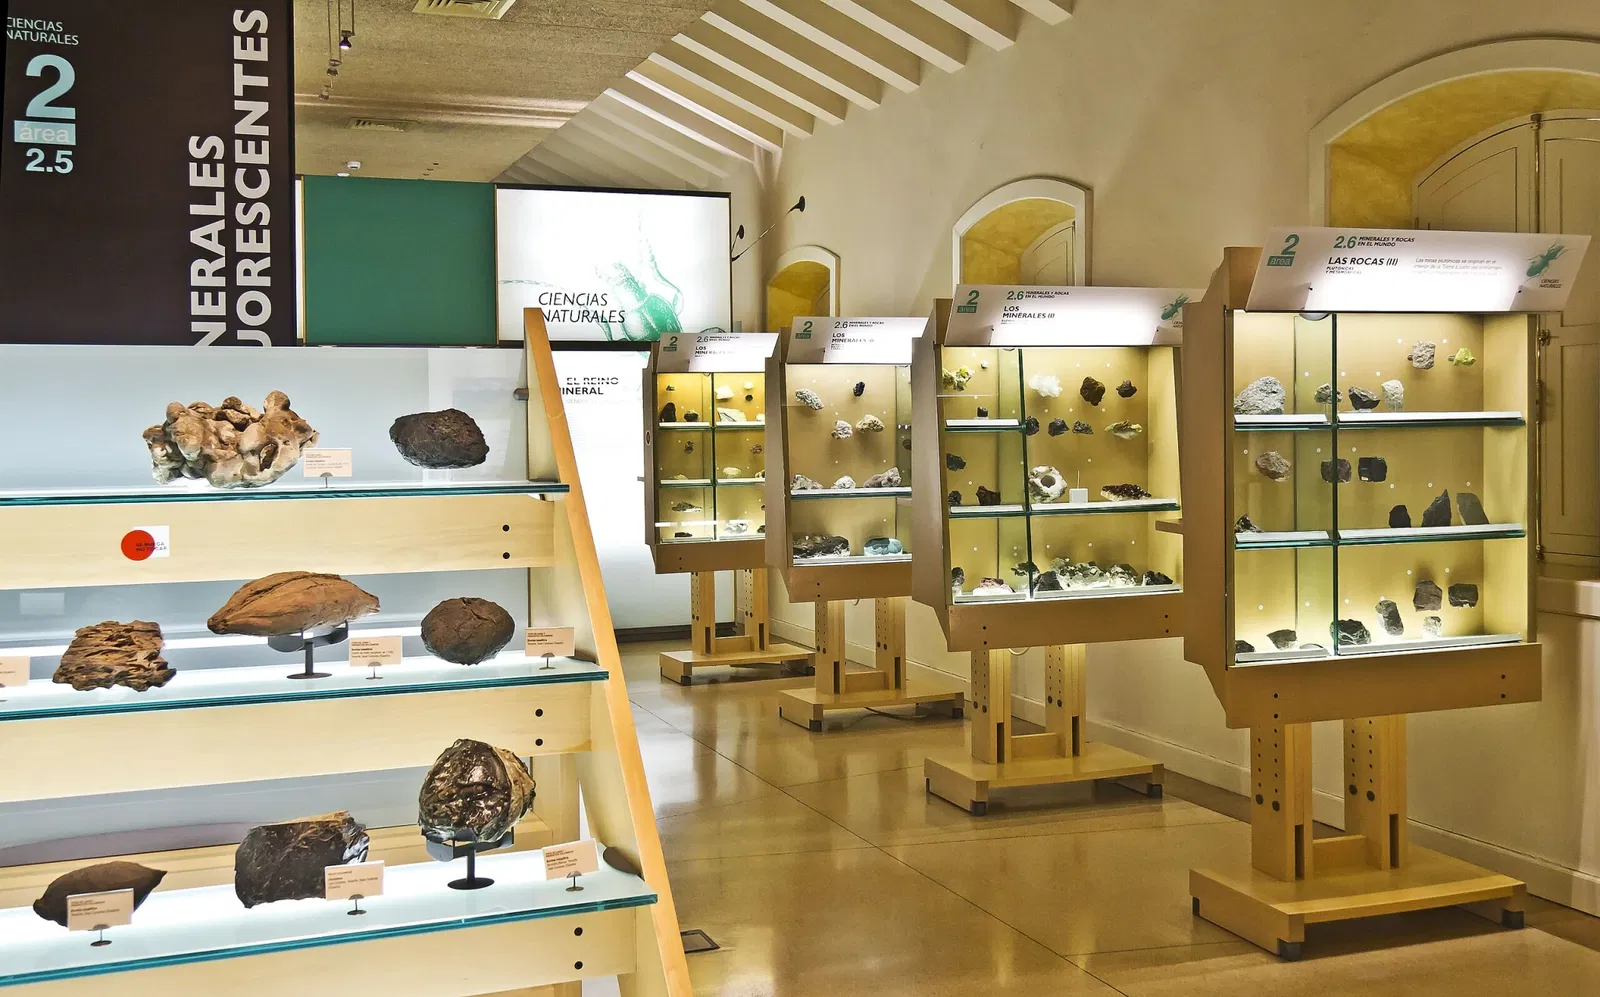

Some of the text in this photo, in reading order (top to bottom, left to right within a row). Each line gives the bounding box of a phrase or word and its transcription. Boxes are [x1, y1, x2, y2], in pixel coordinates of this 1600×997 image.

[6, 16, 63, 32] CIENCIAS
[5, 29, 79, 46] NATURALES
[25, 53, 76, 120] 2
[19, 123, 71, 144] área
[25, 147, 75, 175] 2.5
[1280, 233, 1299, 255] 2
[1332, 235, 1356, 249] 2.6
[1327, 256, 1347, 264] LAS
[1349, 257, 1384, 265] ROCAS
[538, 291, 608, 307] CIENCIAS
[966, 289, 980, 305] 2
[1006, 290, 1024, 300] 2.6
[541, 309, 626, 324] NATURALES
[802, 320, 813, 332] 2
[833, 321, 848, 329] 2.6
[669, 335, 678, 346] 2
[559, 387, 604, 396] INERAL
